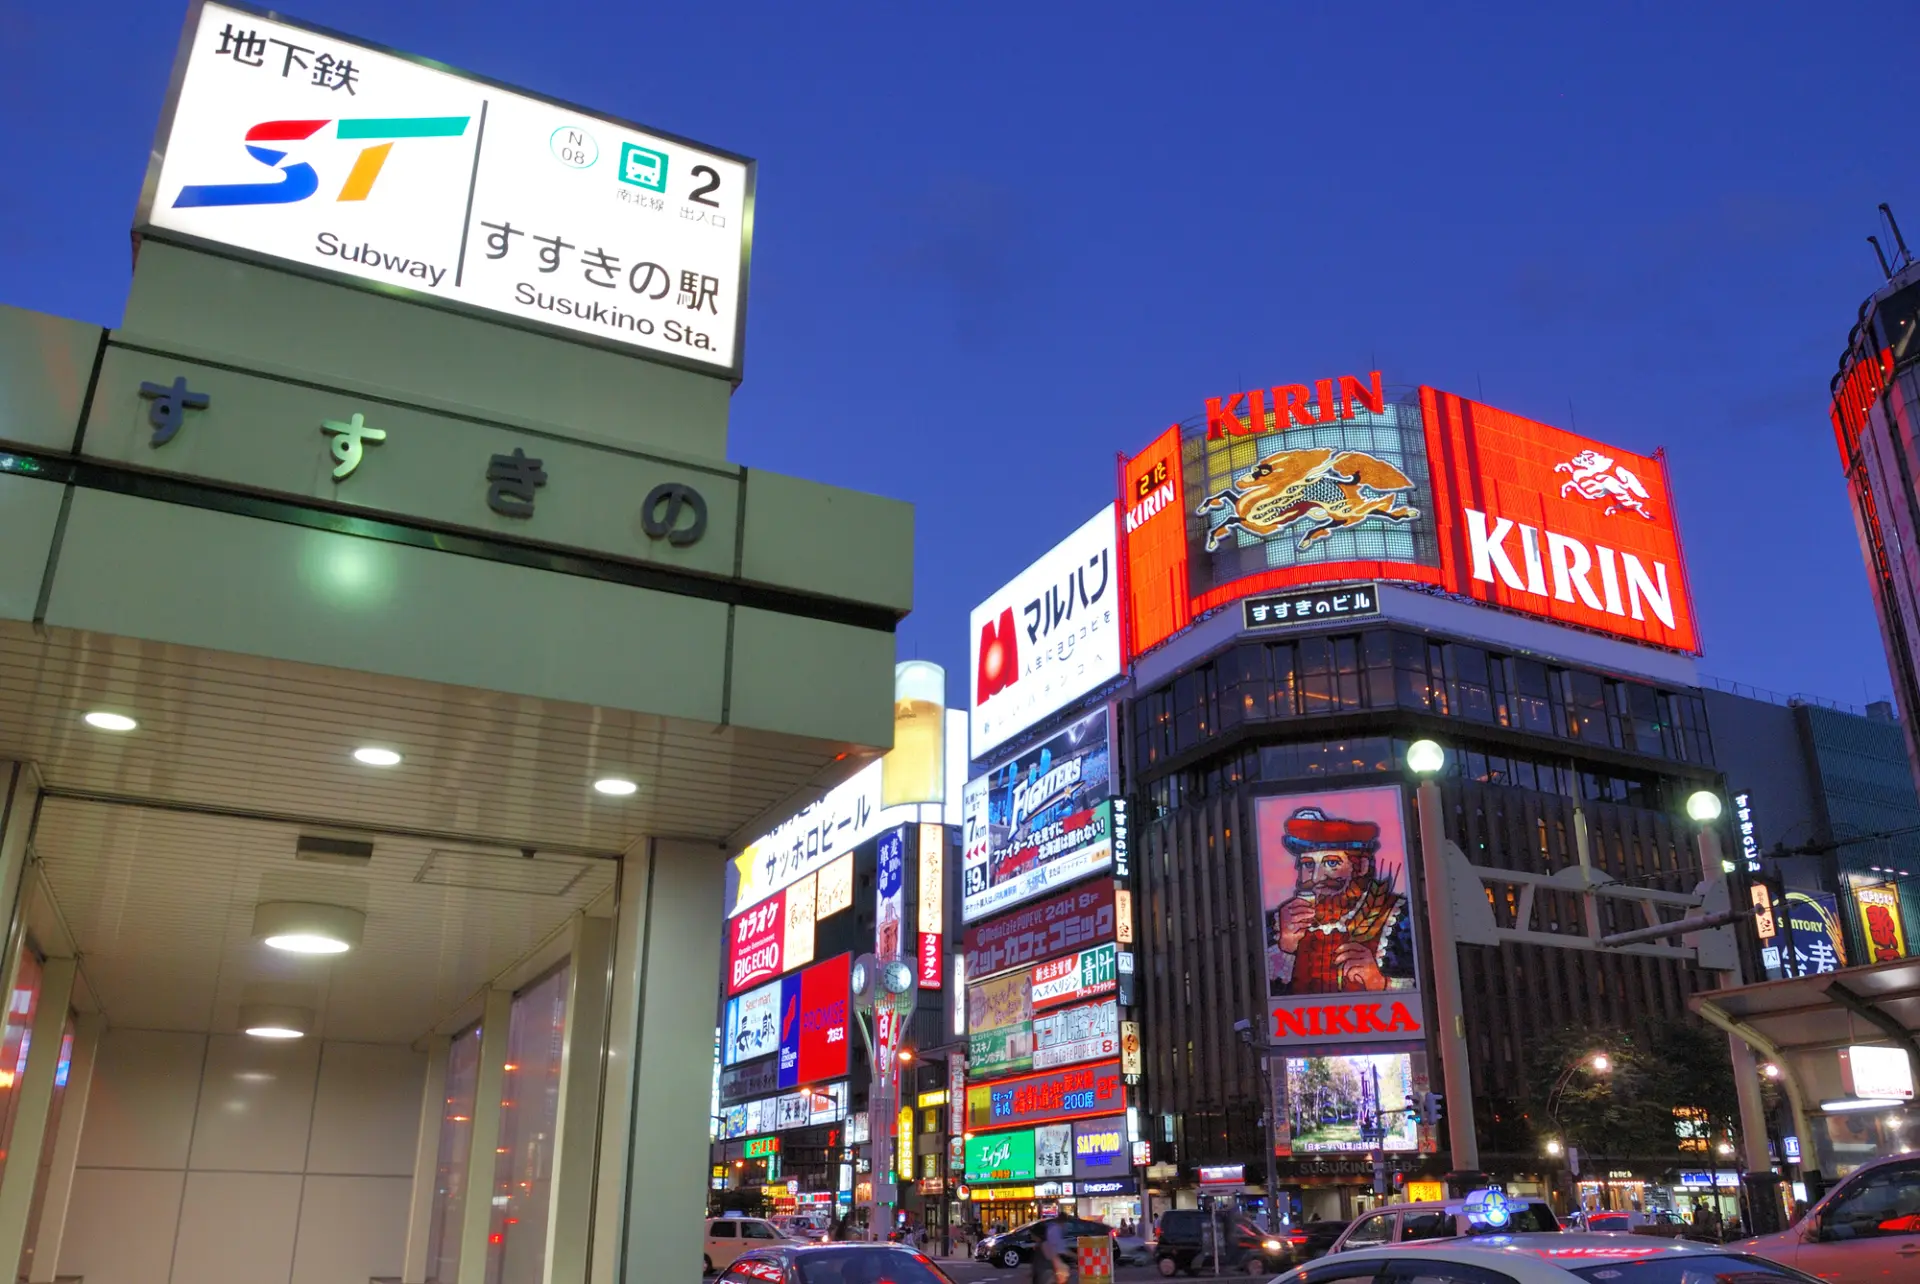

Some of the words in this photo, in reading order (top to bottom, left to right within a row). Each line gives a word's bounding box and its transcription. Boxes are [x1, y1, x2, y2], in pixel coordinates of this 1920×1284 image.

[214, 23, 361, 97] 地下鉄
[560, 147, 587, 167] 08
[567, 129, 584, 147] N
[615, 186, 666, 213] 南北線
[688, 164, 722, 208] 2
[678, 204, 728, 230] 出入口
[315, 231, 448, 288] Subway
[480, 219, 720, 317] すすきの駅
[513, 281, 656, 338] Susukino
[663, 319, 718, 352] Sta.
[1205, 370, 1385, 442] KIRIN
[138, 375, 710, 547] すすきの
[1125, 479, 1175, 534] KIRIN
[1464, 508, 1677, 631] KIRIN
[1023, 547, 1109, 646] マルハン
[1251, 593, 1371, 622] すすきのビル
[1024, 609, 1111, 677] 人生にヨロコビを
[1008, 755, 1083, 840] FIGHTERS
[766, 794, 871, 887] サッポロビール
[967, 814, 987, 842] 7km
[993, 820, 1064, 864] ファイターズを見ずに
[1114, 798, 1129, 876] すすきのビル
[1736, 793, 1761, 873] すすきのビル
[737, 901, 779, 943] カラオケ
[1045, 897, 1076, 921] 24H
[1079, 892, 1099, 909] 8F
[1777, 916, 1823, 933] SNTORY
[733, 955, 752, 987] BIG
[751, 942, 780, 971] ECHO
[924, 933, 937, 979] カラオケ
[1082, 950, 1114, 986] 青汁
[1033, 976, 1080, 998] ヘスペリジン
[803, 999, 845, 1033] PROMISE
[1088, 1000, 1118, 1039] 24H
[1273, 1001, 1421, 1039] NIKKA
[971, 1040, 992, 1054] ススキノ
[1073, 1040, 1100, 1060] POPEYE
[1096, 1075, 1119, 1100] 2F
[1124, 1073, 1140, 1086] 4F
[1064, 1090, 1094, 1110] 200席
[981, 1143, 1010, 1168] エイブル
[1076, 1132, 1120, 1154] SAPPORO
[1300, 1160, 1374, 1175] SUSUKINO
[994, 1190, 1015, 1199] LOTTERIA
